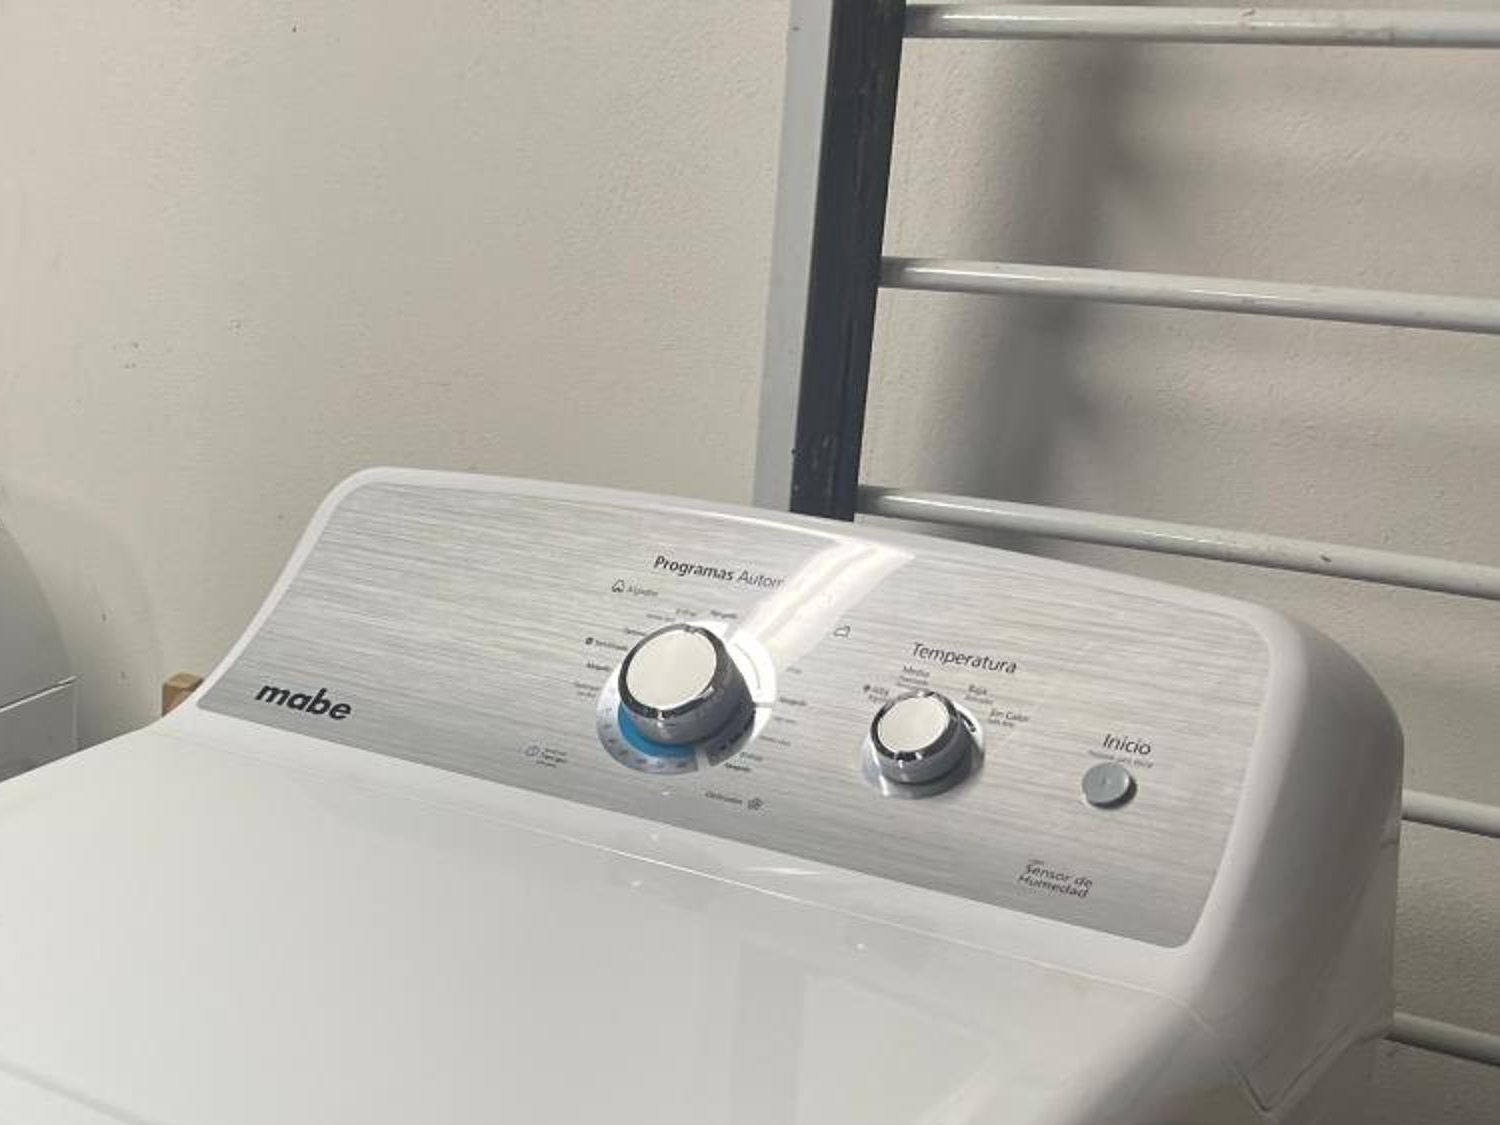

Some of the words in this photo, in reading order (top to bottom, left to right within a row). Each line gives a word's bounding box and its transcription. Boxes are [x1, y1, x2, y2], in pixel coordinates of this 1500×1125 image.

[653, 555, 734, 582] Programas
[736, 570, 785, 590] Autom
[911, 642, 1018, 674] Temperatura
[255, 685, 351, 720] mabe
[1102, 733, 1153, 756] Inicio
[1018, 874, 1089, 898] Humedad
[1025, 864, 1071, 883] Sensor
[1073, 875, 1094, 889] de
